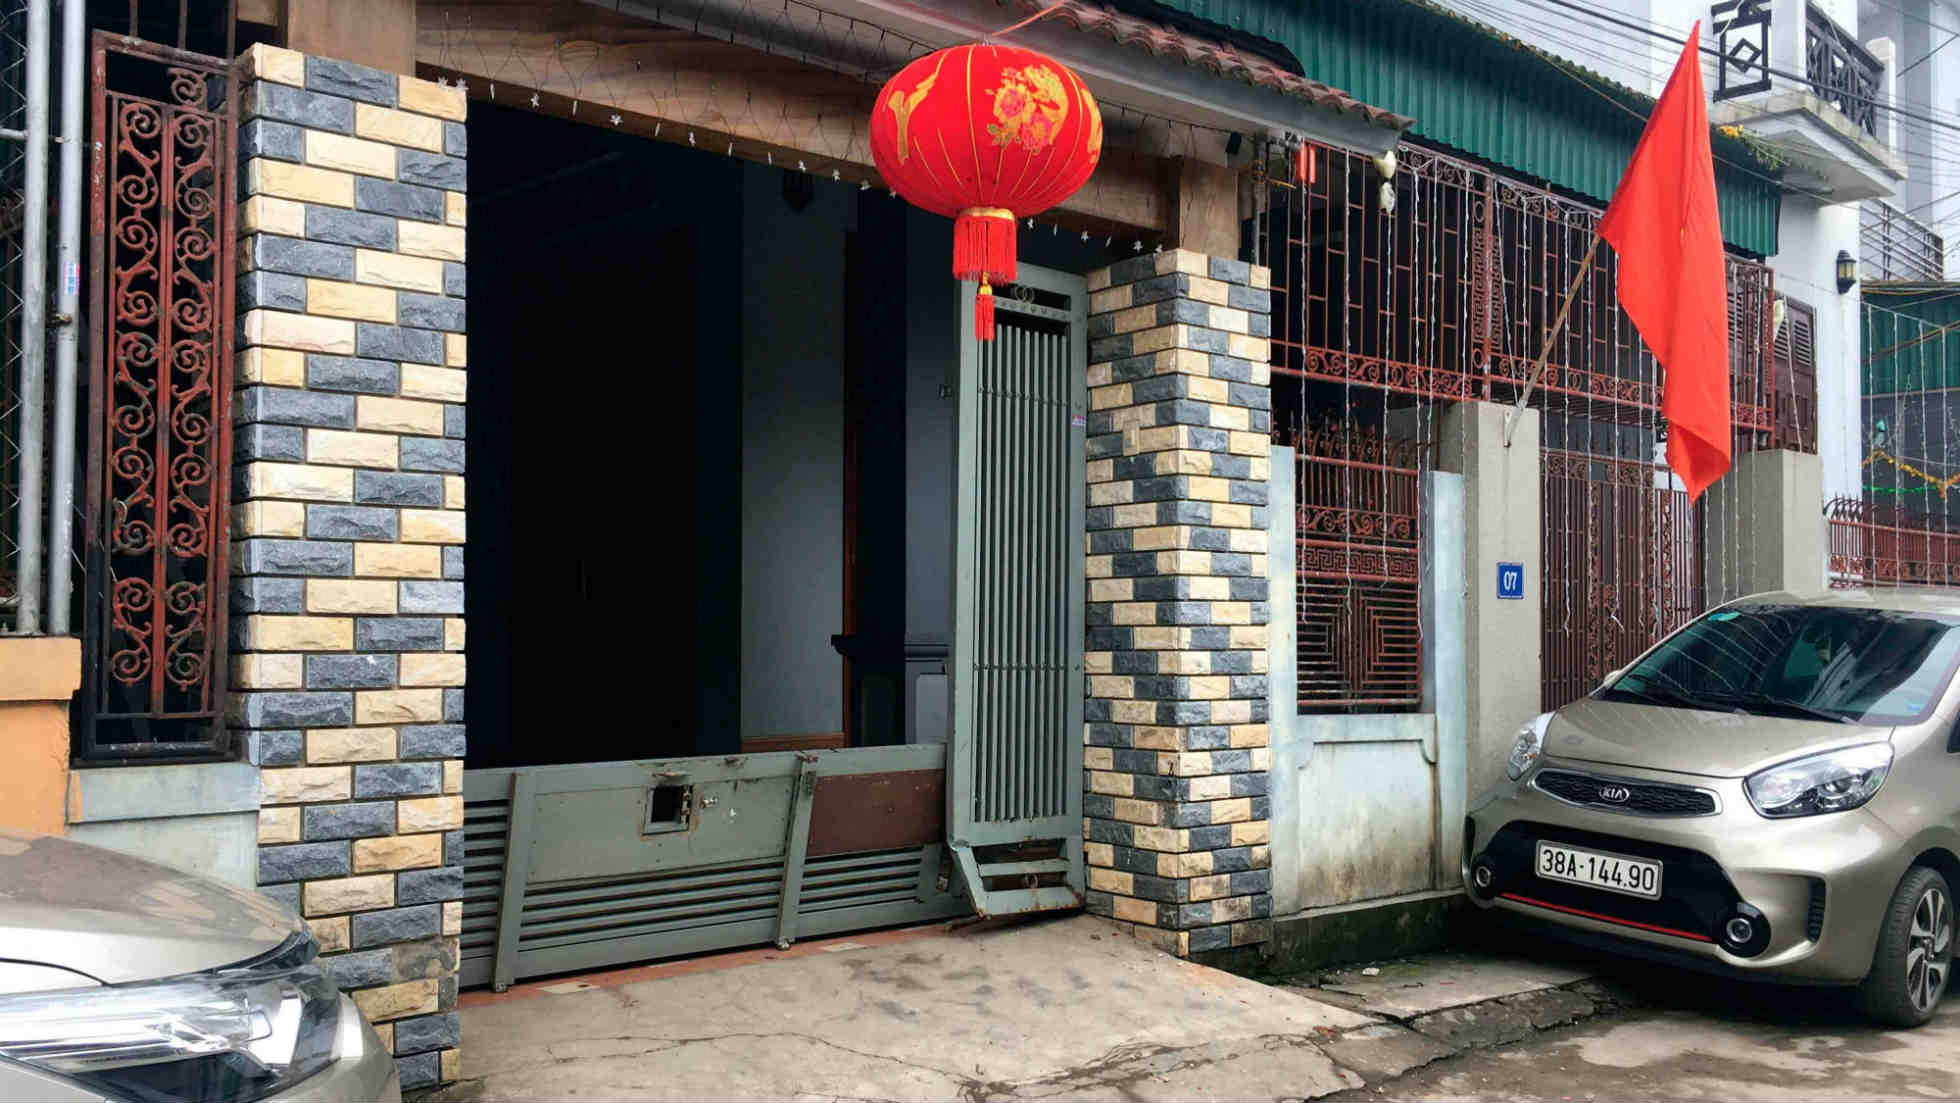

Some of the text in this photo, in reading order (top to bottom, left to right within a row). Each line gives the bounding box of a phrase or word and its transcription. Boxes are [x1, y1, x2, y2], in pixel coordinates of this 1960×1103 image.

[1503, 570, 1518, 591] 07
[1602, 786, 1624, 800] KIA
[1542, 849, 1656, 891] 38A-144.90
